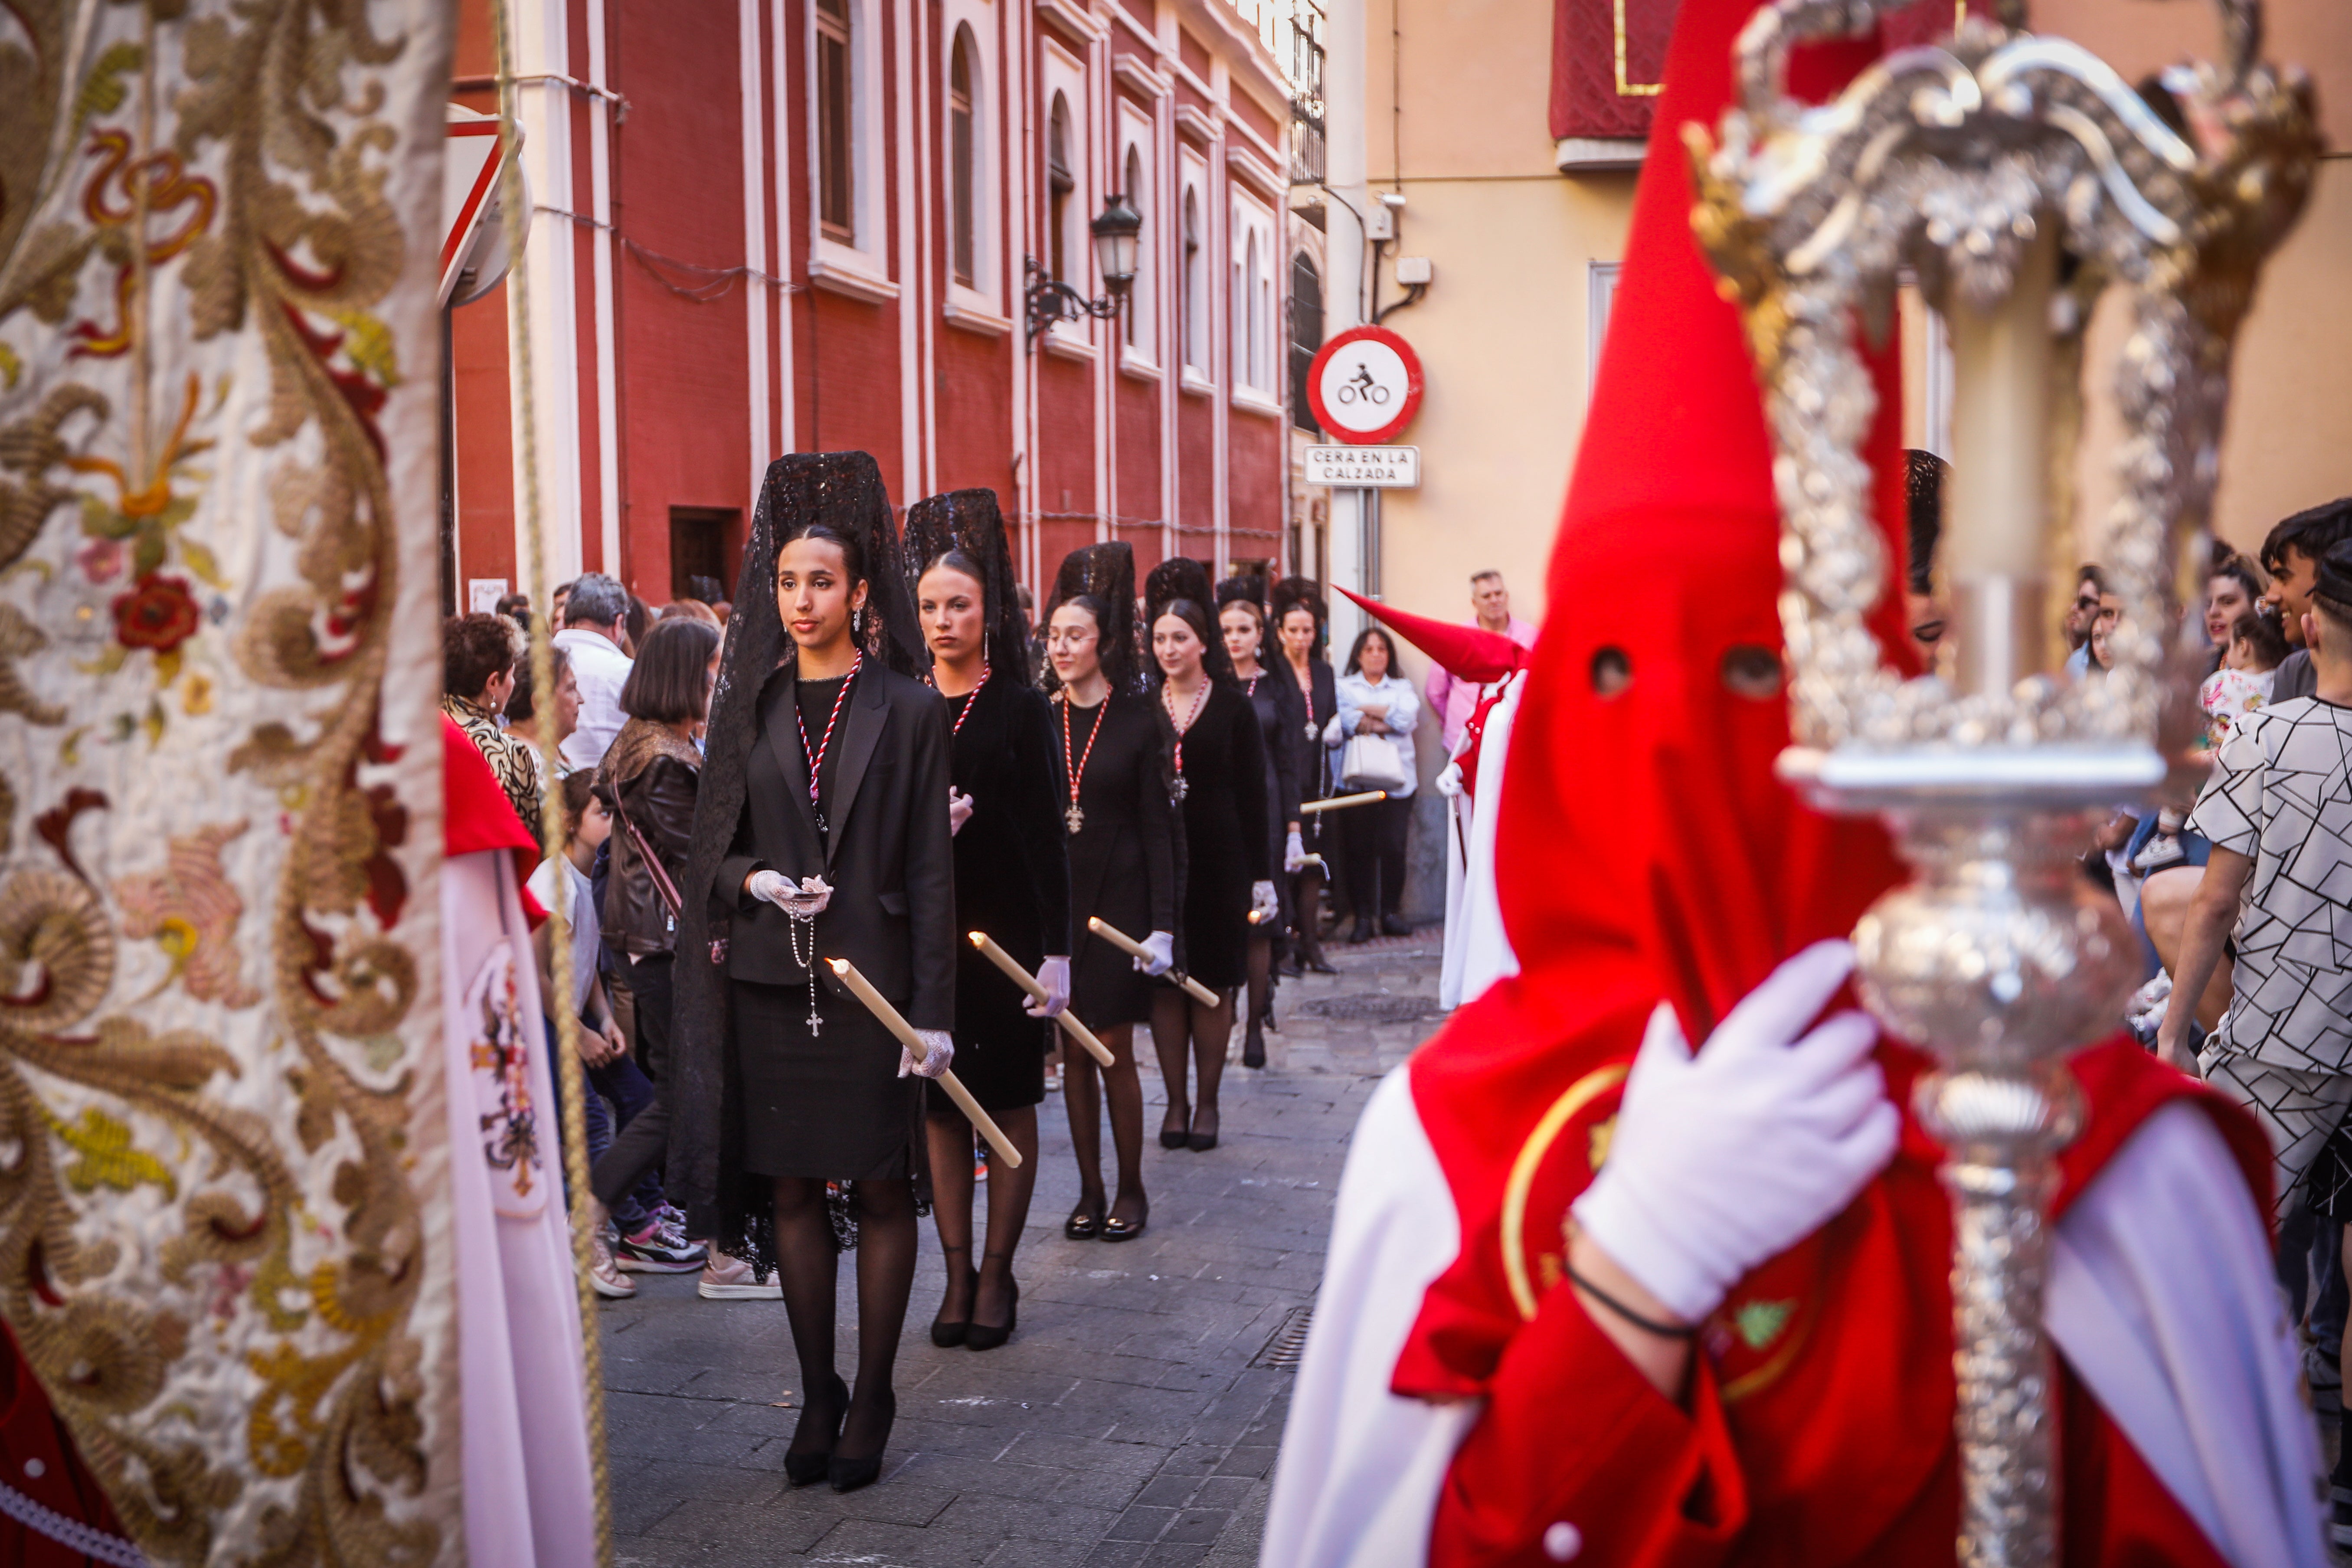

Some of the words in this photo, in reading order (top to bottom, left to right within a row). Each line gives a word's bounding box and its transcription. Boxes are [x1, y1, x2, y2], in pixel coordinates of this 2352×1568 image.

[1314, 451, 1355, 462] CERA
[1361, 452, 1381, 463] EN
[1389, 452, 1407, 463] LA
[1324, 468, 1395, 479] CALZADA
